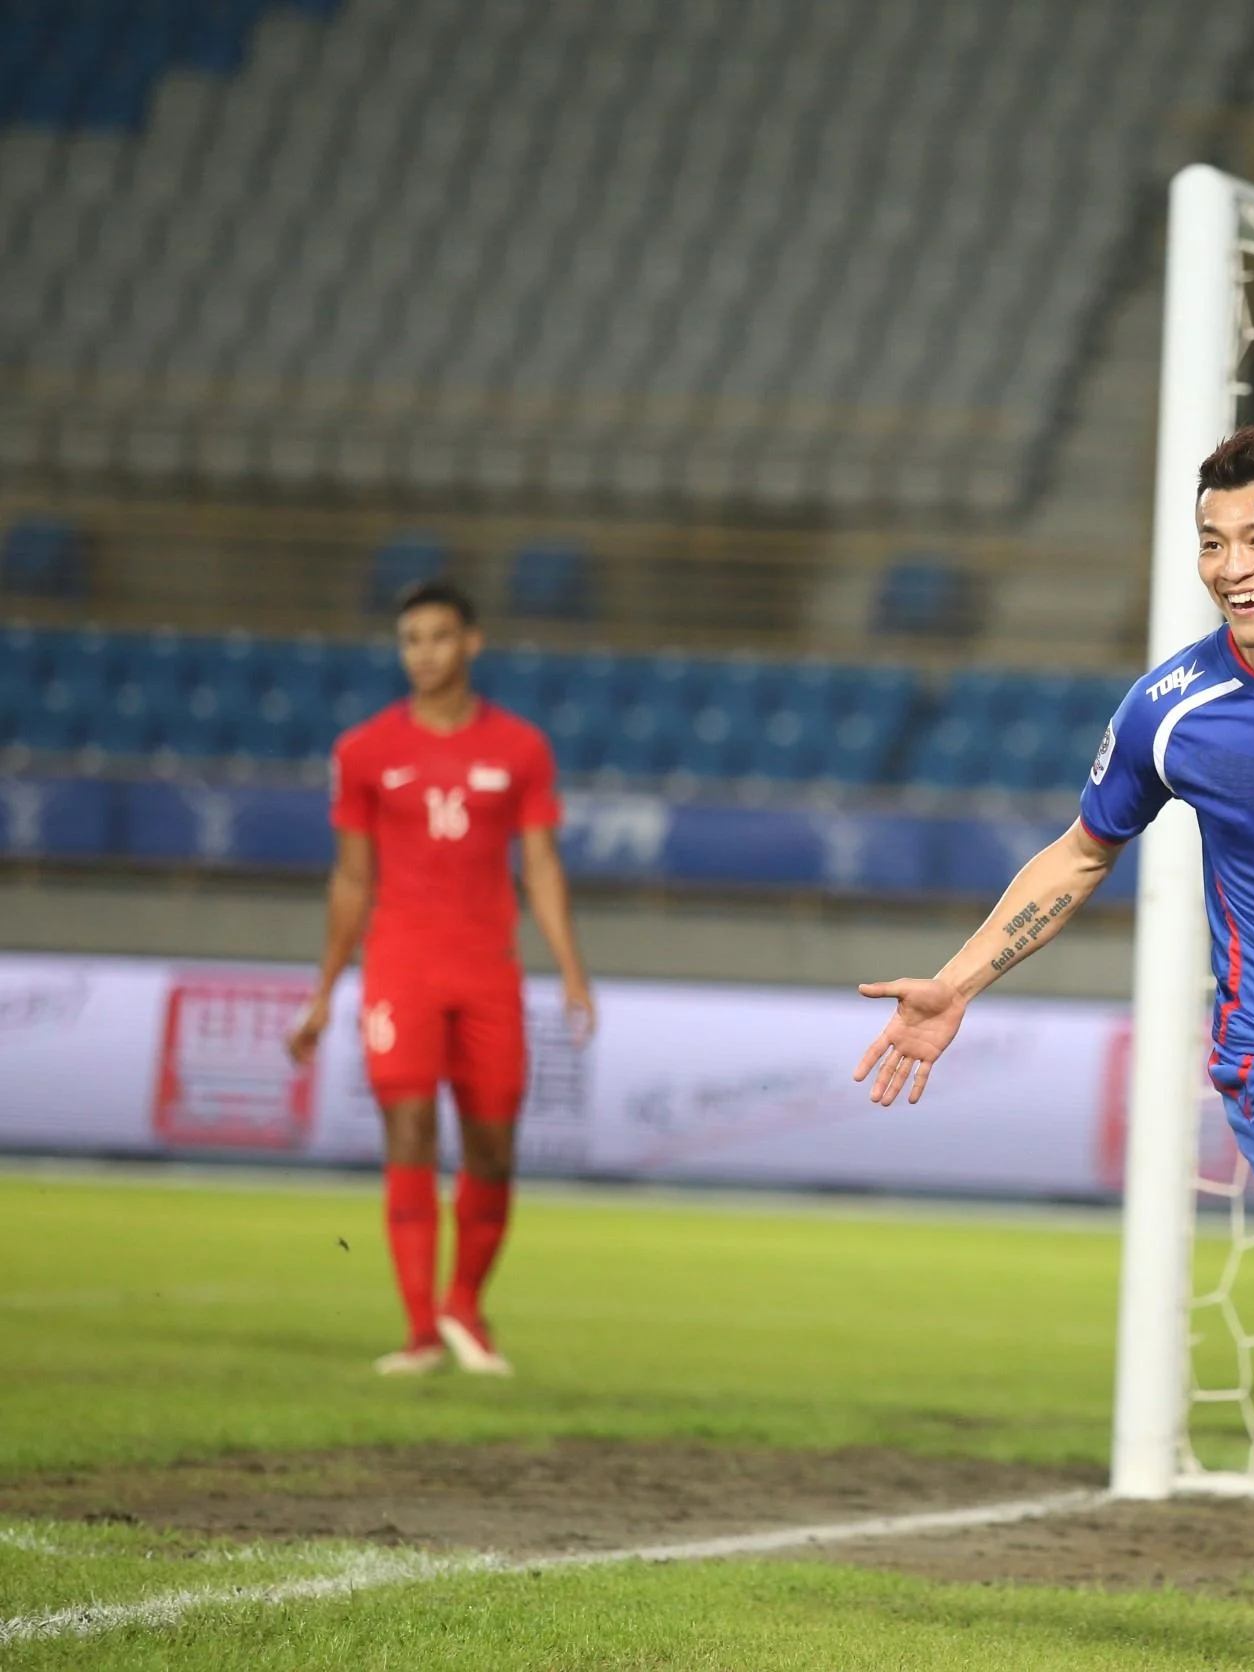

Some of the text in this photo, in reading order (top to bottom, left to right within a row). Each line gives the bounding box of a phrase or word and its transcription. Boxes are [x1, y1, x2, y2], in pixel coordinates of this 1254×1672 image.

[424, 786, 471, 840] 16
[1015, 936, 1029, 950] on
[1027, 915, 1051, 940] pain
[1049, 893, 1072, 917] ends
